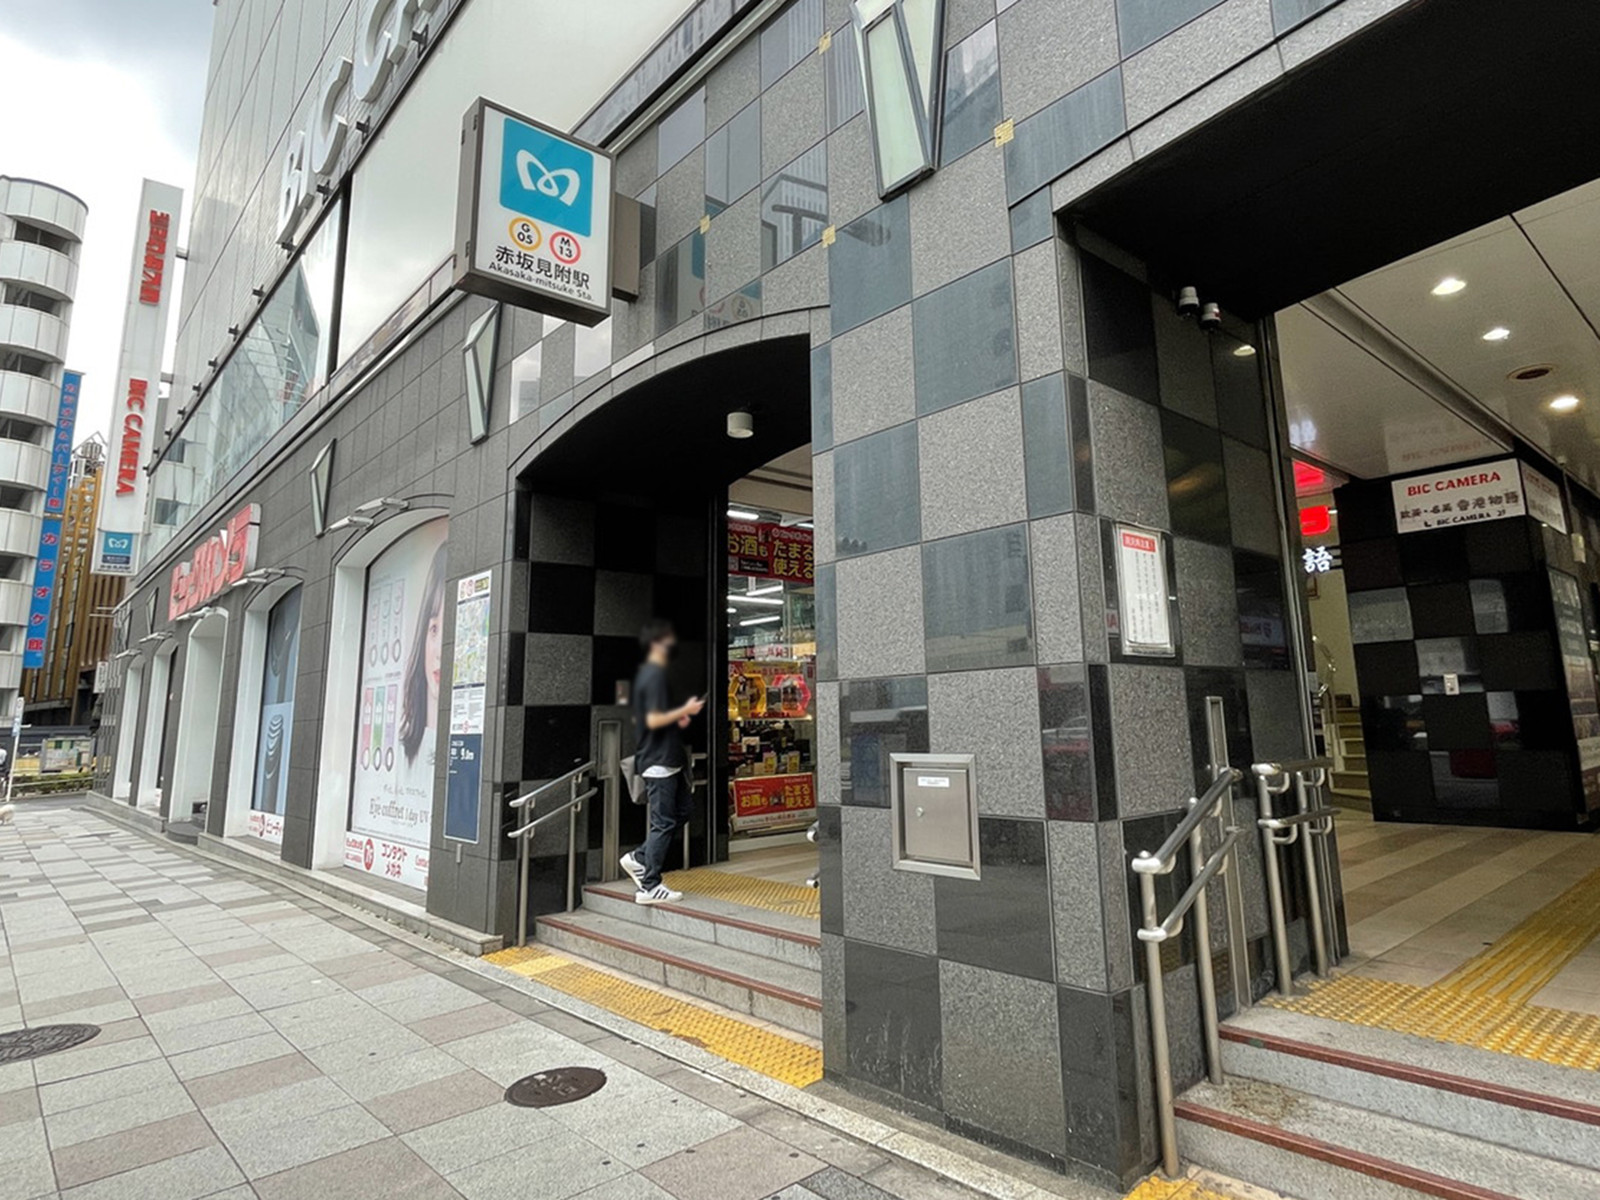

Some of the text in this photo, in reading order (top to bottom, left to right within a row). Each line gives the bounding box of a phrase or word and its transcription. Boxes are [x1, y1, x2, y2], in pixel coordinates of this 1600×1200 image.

[516, 231, 533, 245] 05
[520, 223, 531, 233] G
[558, 246, 573, 259] 13
[488, 261, 574, 296] Akasaka-mitsuke
[495, 245, 591, 290] 赤坂見附駅
[115, 378, 148, 498] BIC CAMERA
[1407, 471, 1502, 497] BIC CAMERA
[1452, 511, 1492, 524] CAMERA
[773, 539, 815, 561] たまる
[773, 557, 815, 580] 使える
